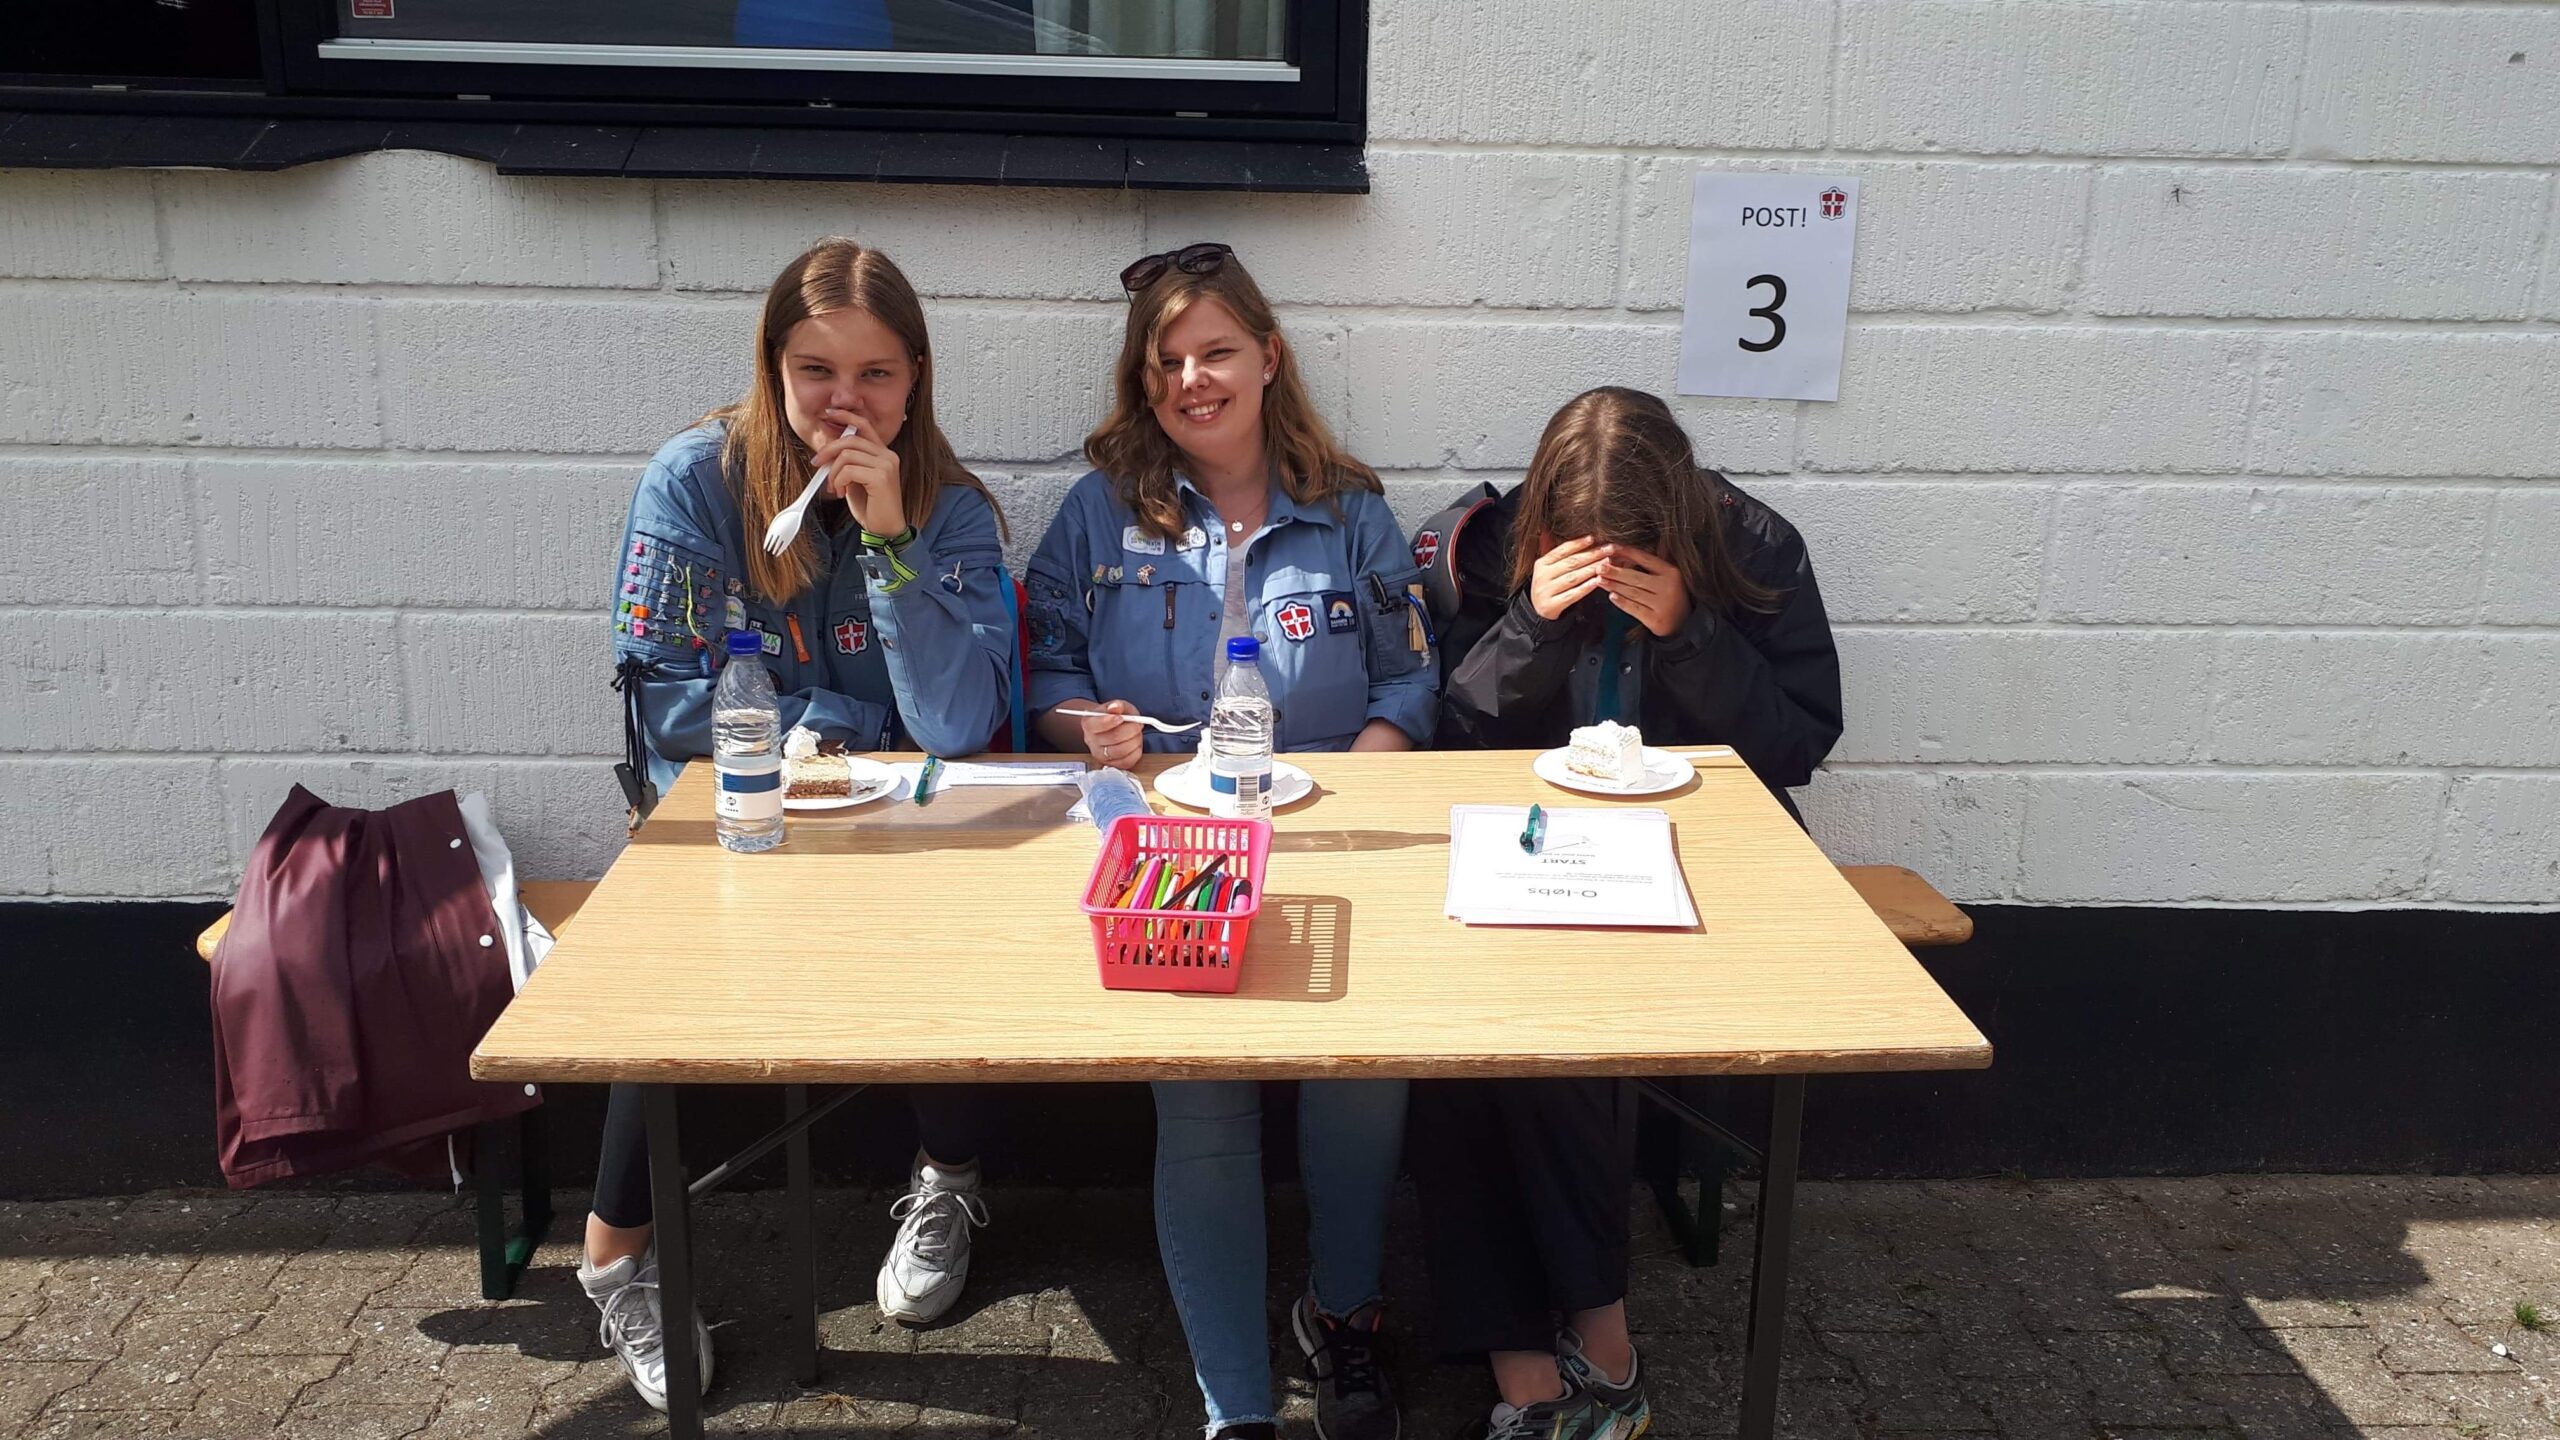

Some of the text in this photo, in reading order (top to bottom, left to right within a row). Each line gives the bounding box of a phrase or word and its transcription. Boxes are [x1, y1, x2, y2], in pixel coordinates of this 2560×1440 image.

[1742, 207, 1806, 228] POST!
[1738, 274, 1787, 352] 3
[1528, 887, 1598, 898] O-løbs
